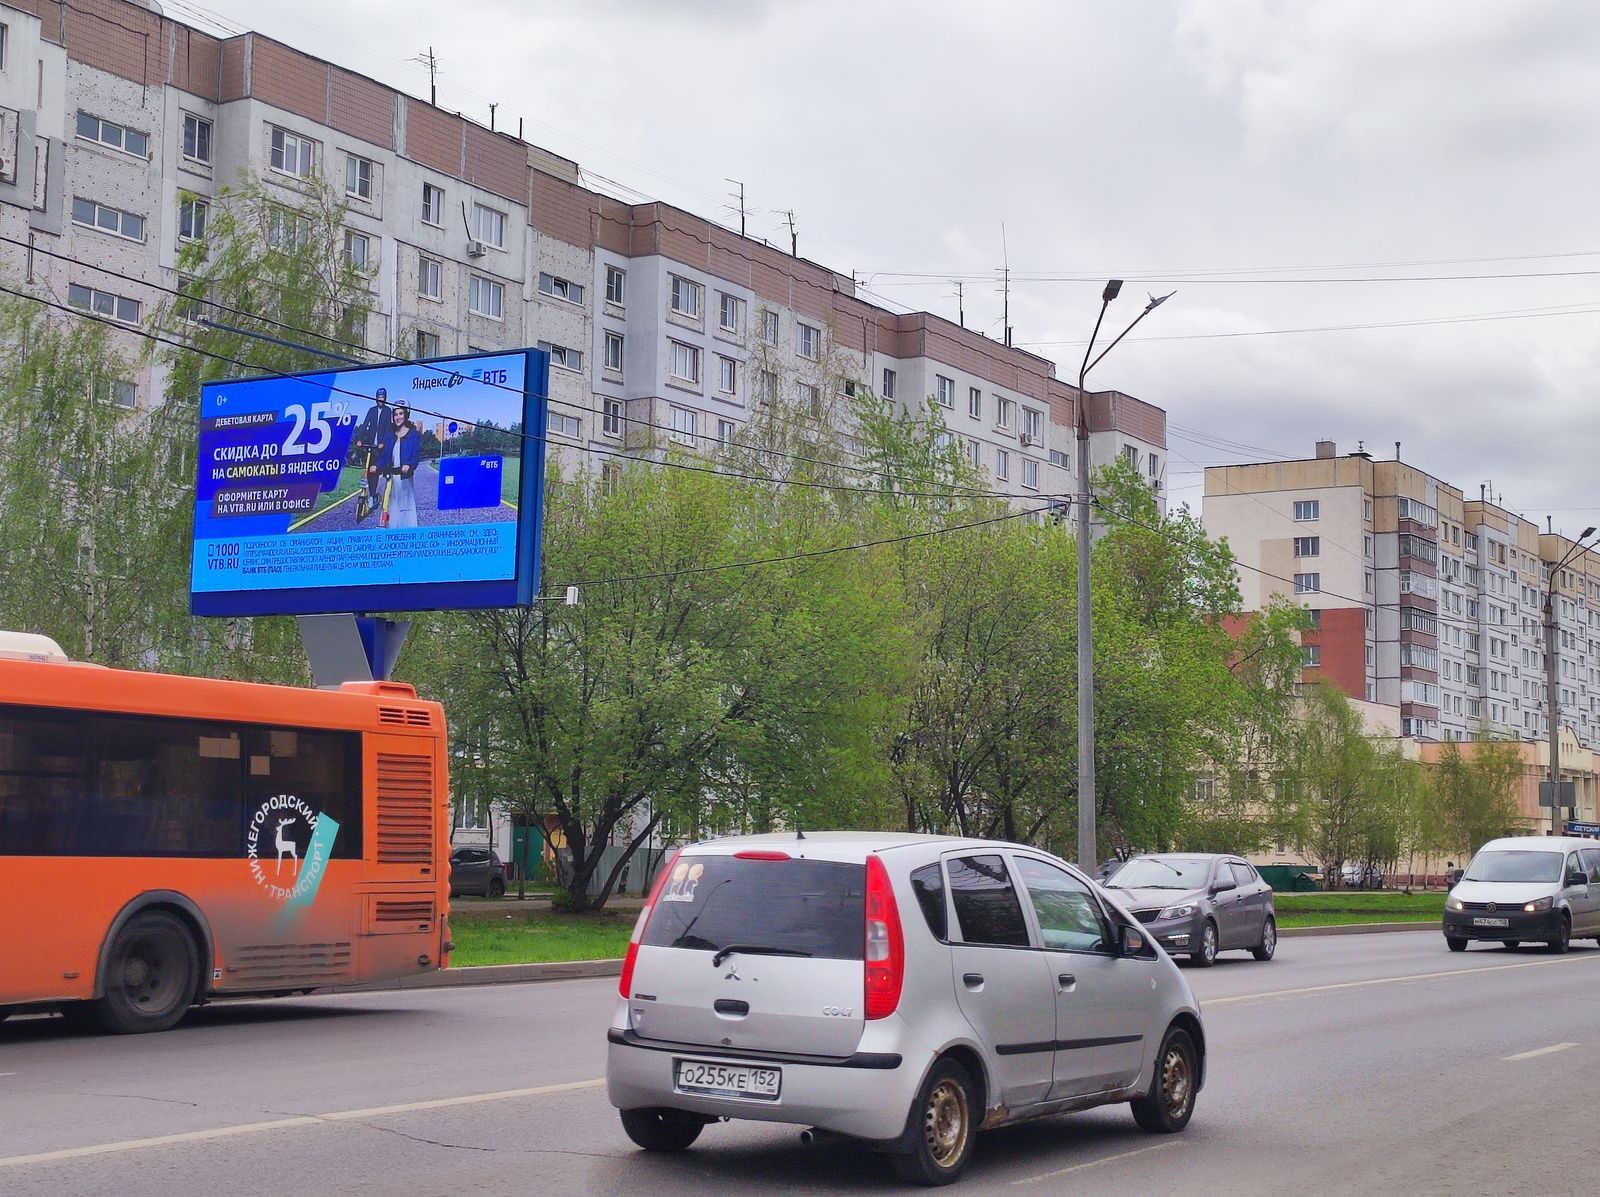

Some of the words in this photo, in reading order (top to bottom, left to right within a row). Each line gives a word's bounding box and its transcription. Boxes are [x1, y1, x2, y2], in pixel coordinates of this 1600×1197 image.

[412, 377, 448, 390] Яндекс
[483, 370, 507, 384] ВТБ
[217, 396, 228, 405] 0+
[215, 416, 251, 427] ДЕБЕТОВАЯ
[252, 414, 273, 422] КАРТА
[214, 445, 259, 461] СКИДКА
[261, 444, 278, 461] ДО
[212, 468, 224, 479] НА
[227, 464, 278, 478] САМОКАТЫ
[280, 464, 286, 474] В
[288, 460, 323, 474] ЯНДЕКС
[326, 459, 339, 470] GO
[486, 460, 498, 468] ВТБ
[218, 491, 261, 502] ОФОРМИТЕ
[263, 489, 288, 499] КАРТУ
[218, 504, 228, 514] НА
[230, 502, 256, 513] VTB.RU
[258, 501, 274, 511] ИЛИ
[276, 500, 280, 509] В
[282, 499, 310, 509] ОФИСЕ
[216, 543, 239, 556] 1000
[208, 558, 239, 570] VTB.RU
[248, 795, 320, 884] НИЖЕГОРОДСКИЙ
[270, 841, 323, 899] ТРАНСПОРТ
[823, 1006, 853, 1018] COLT
[685, 1066, 746, 1088] О255КЕ
[751, 1070, 775, 1086] 152
